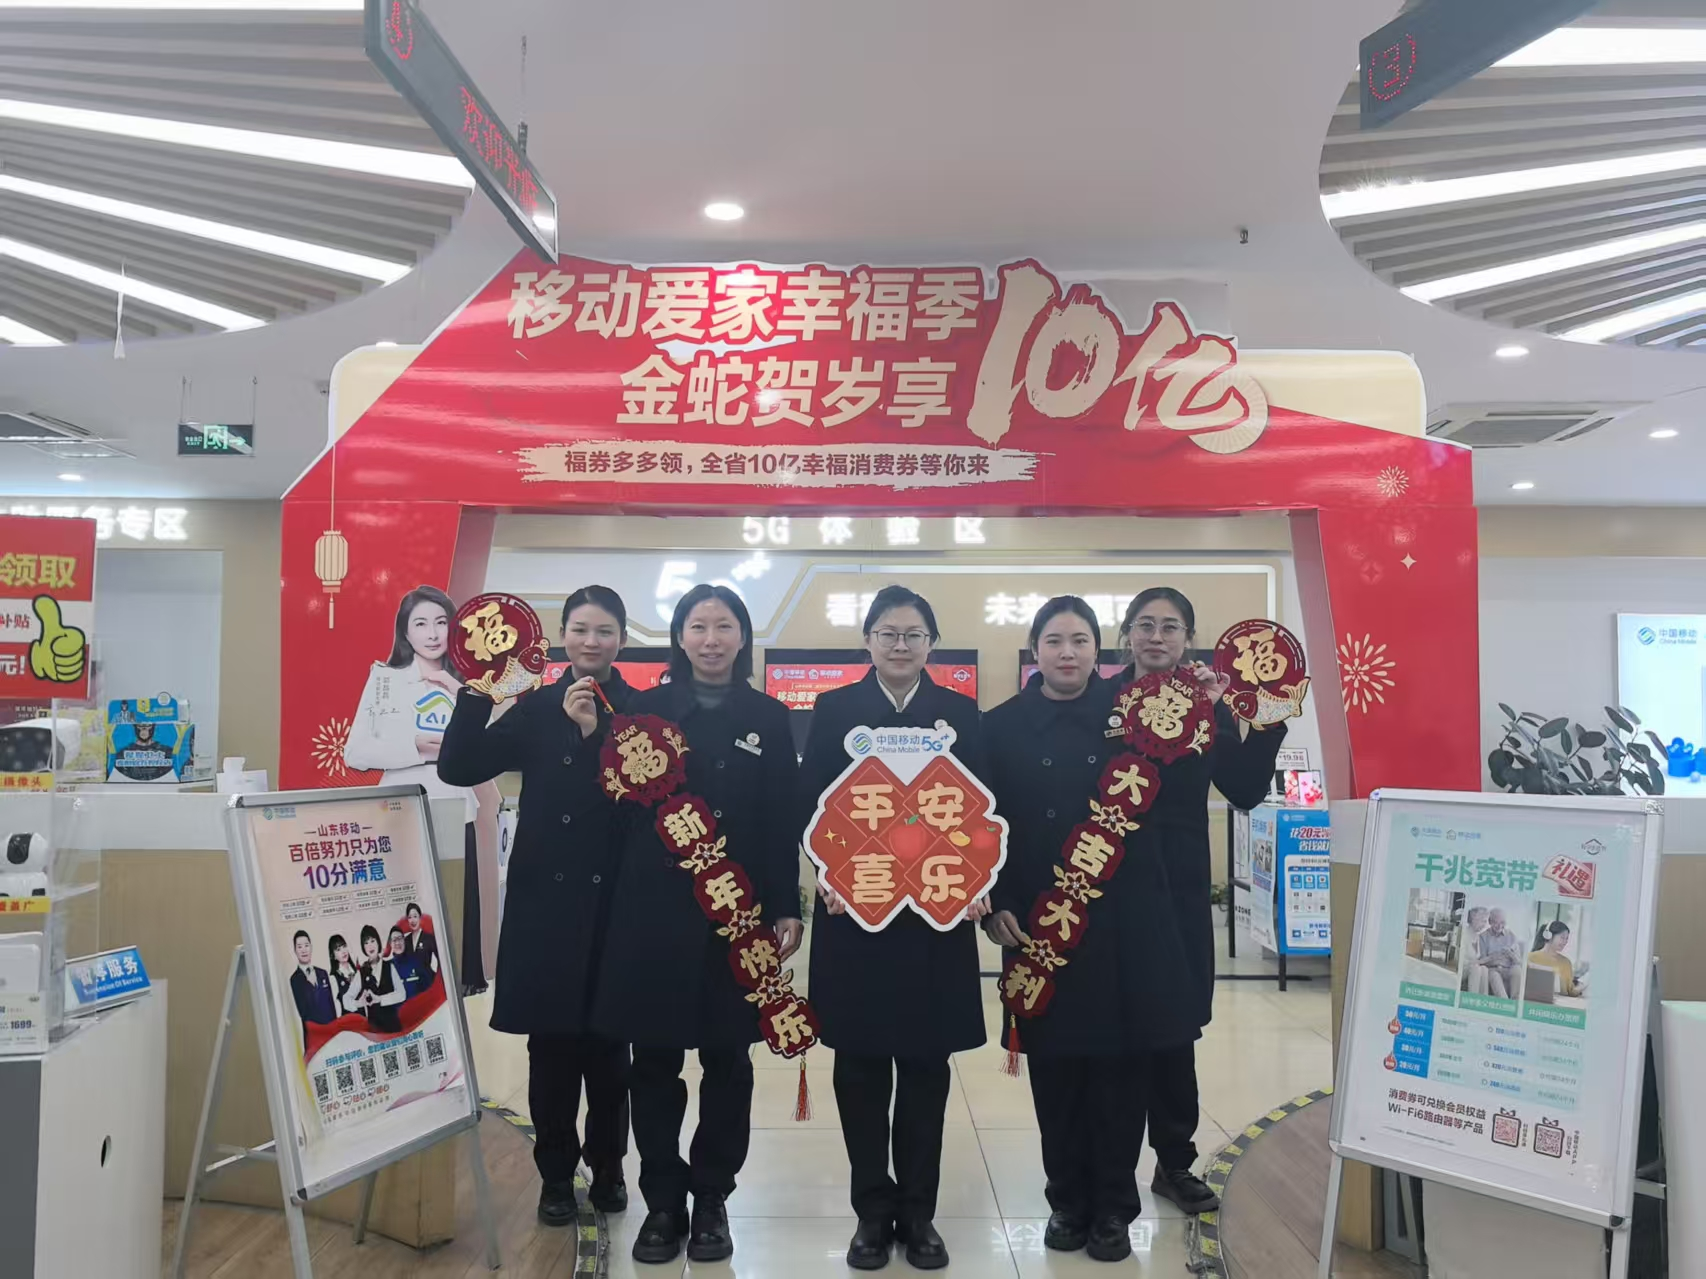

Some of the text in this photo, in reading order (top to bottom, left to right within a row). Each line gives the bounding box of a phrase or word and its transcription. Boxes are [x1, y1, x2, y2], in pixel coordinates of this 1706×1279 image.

[507, 268, 980, 341] 移动爱家幸福季
[967, 265, 1247, 450] 10亿
[616, 355, 957, 428] 金蛇贺岁享
[0, 553, 76, 588] 领取
[460, 601, 518, 661] 福
[1659, 629, 1697, 638] 中国移动
[1233, 629, 1287, 685] 福
[1170, 677, 1194, 698] YEAR
[1138, 684, 1193, 739] 福
[614, 724, 638, 743] YEAR
[877, 735, 920, 746] 中国移动
[877, 746, 920, 754] China Mobile
[617, 731, 669, 784] 福
[0, 776, 41, 787] 摄像头
[850, 782, 965, 832] 平安
[318, 822, 360, 837] 山东移动
[288, 836, 392, 863] 百倍努力只为您
[303, 858, 387, 889] 10分满意
[851, 853, 968, 904] 喜乐
[1415, 853, 1539, 892] 千兆宽带
[1387, 1102, 1484, 1135] Wi-Fi6路由器等产品
[1388, 1087, 1487, 1121] 消费券可兑换会员权益
